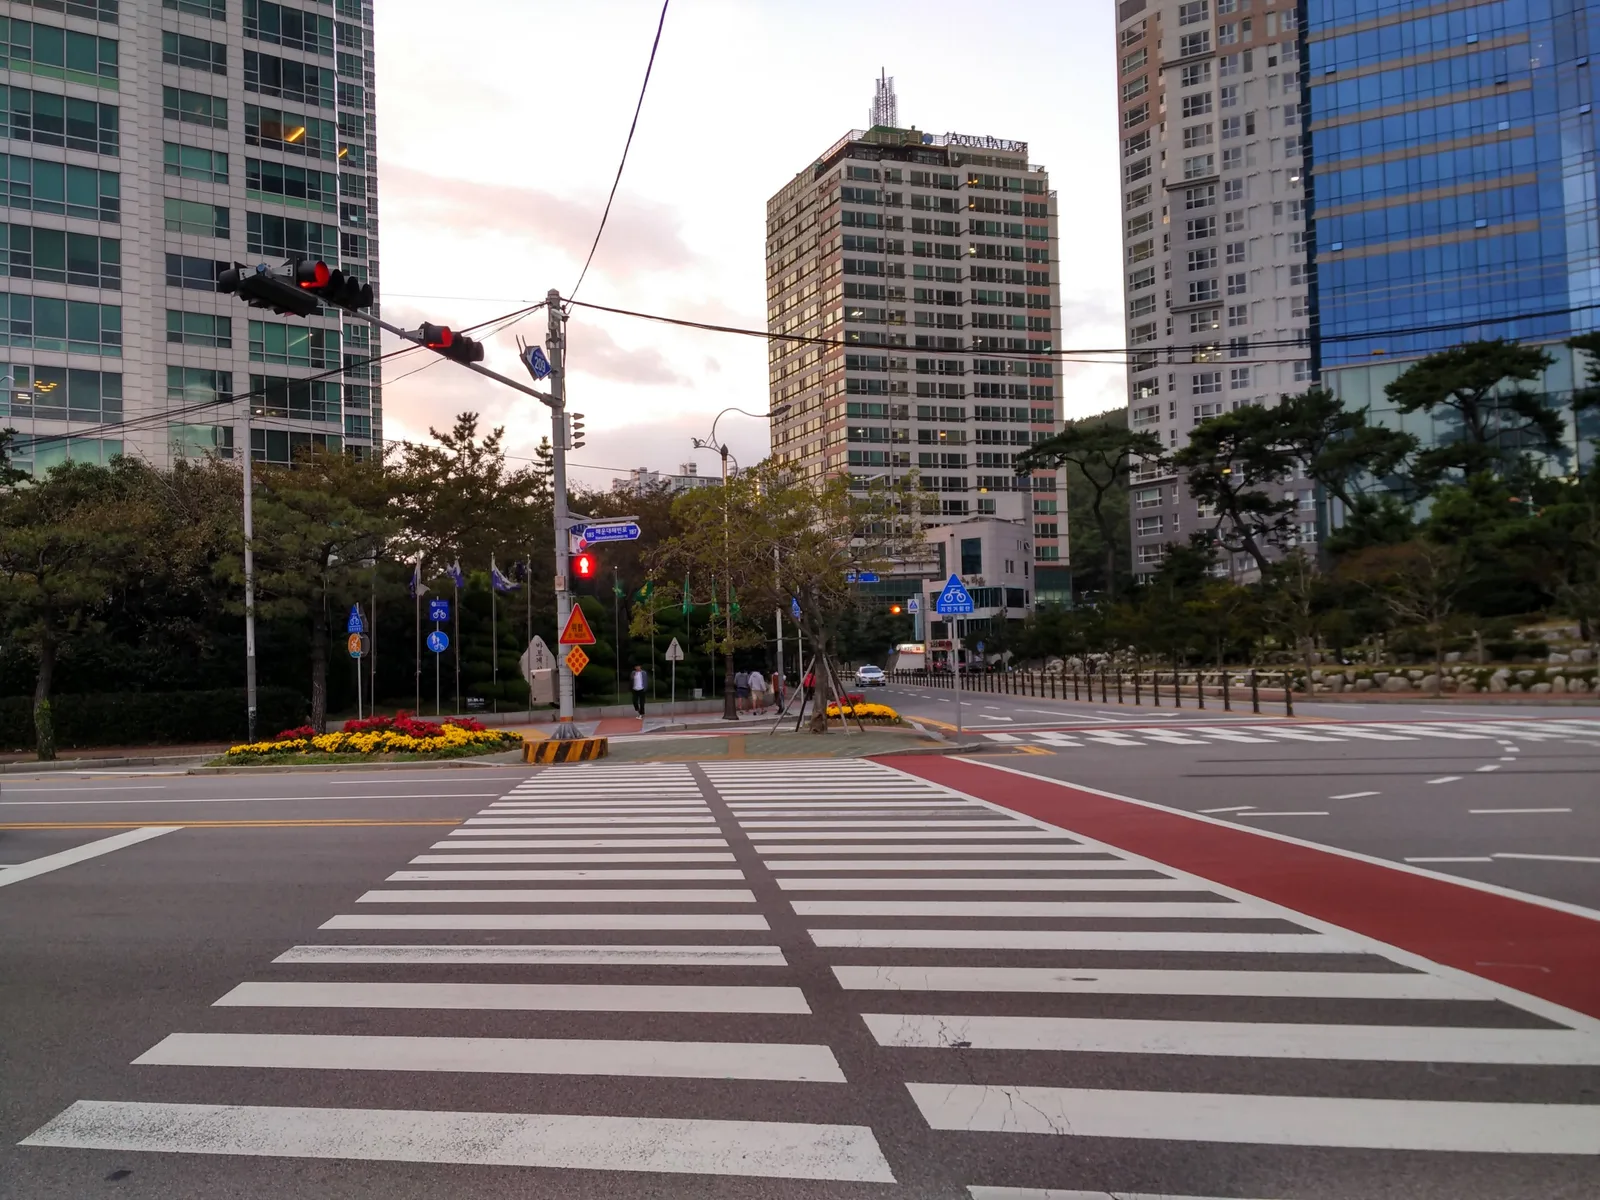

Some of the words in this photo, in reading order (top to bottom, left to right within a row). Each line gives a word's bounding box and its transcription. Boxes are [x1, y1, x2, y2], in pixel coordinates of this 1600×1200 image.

[950, 131, 983, 148] AQUA
[986, 135, 1028, 152] PALACE
[534, 356, 546, 372] 209
[595, 526, 628, 535] 해운대해변로
[940, 605, 971, 613] 자전거횡단
[571, 623, 584, 633] 위험
